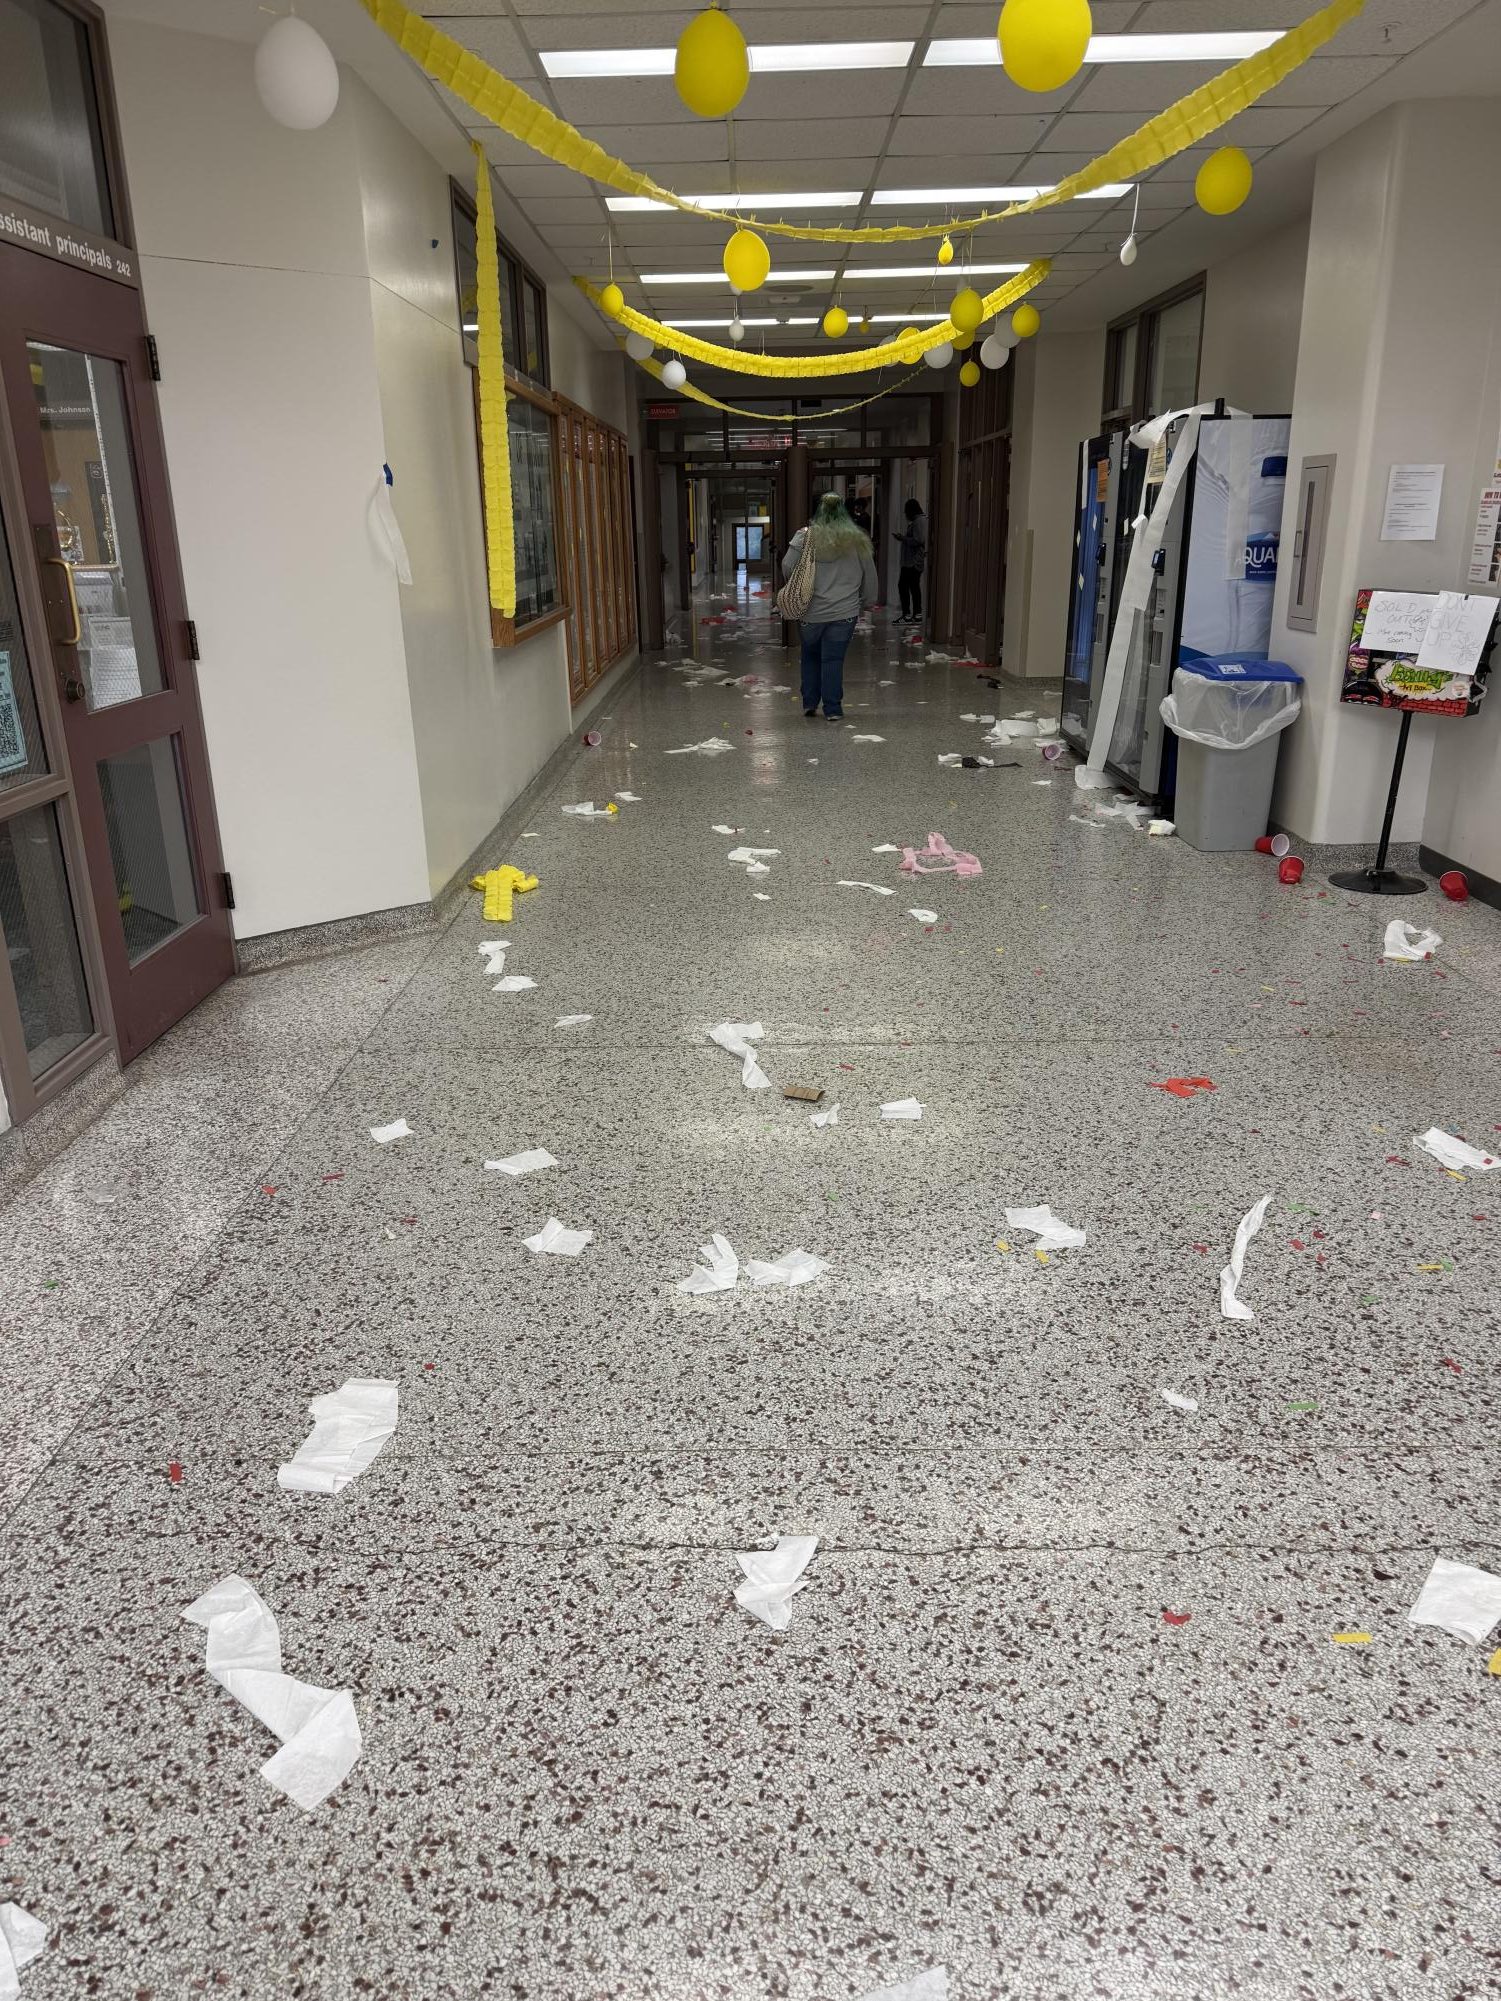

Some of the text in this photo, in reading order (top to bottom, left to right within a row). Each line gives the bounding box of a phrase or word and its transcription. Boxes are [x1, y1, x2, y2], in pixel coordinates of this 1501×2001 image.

[56, 235, 112, 270] principals
[117, 260, 131, 277] 242
[58, 406, 91, 414] Johnson
[1375, 600, 1417, 613] SOLD
[1430, 610, 1469, 632] GIVE
[1427, 631, 1452, 647] UP
